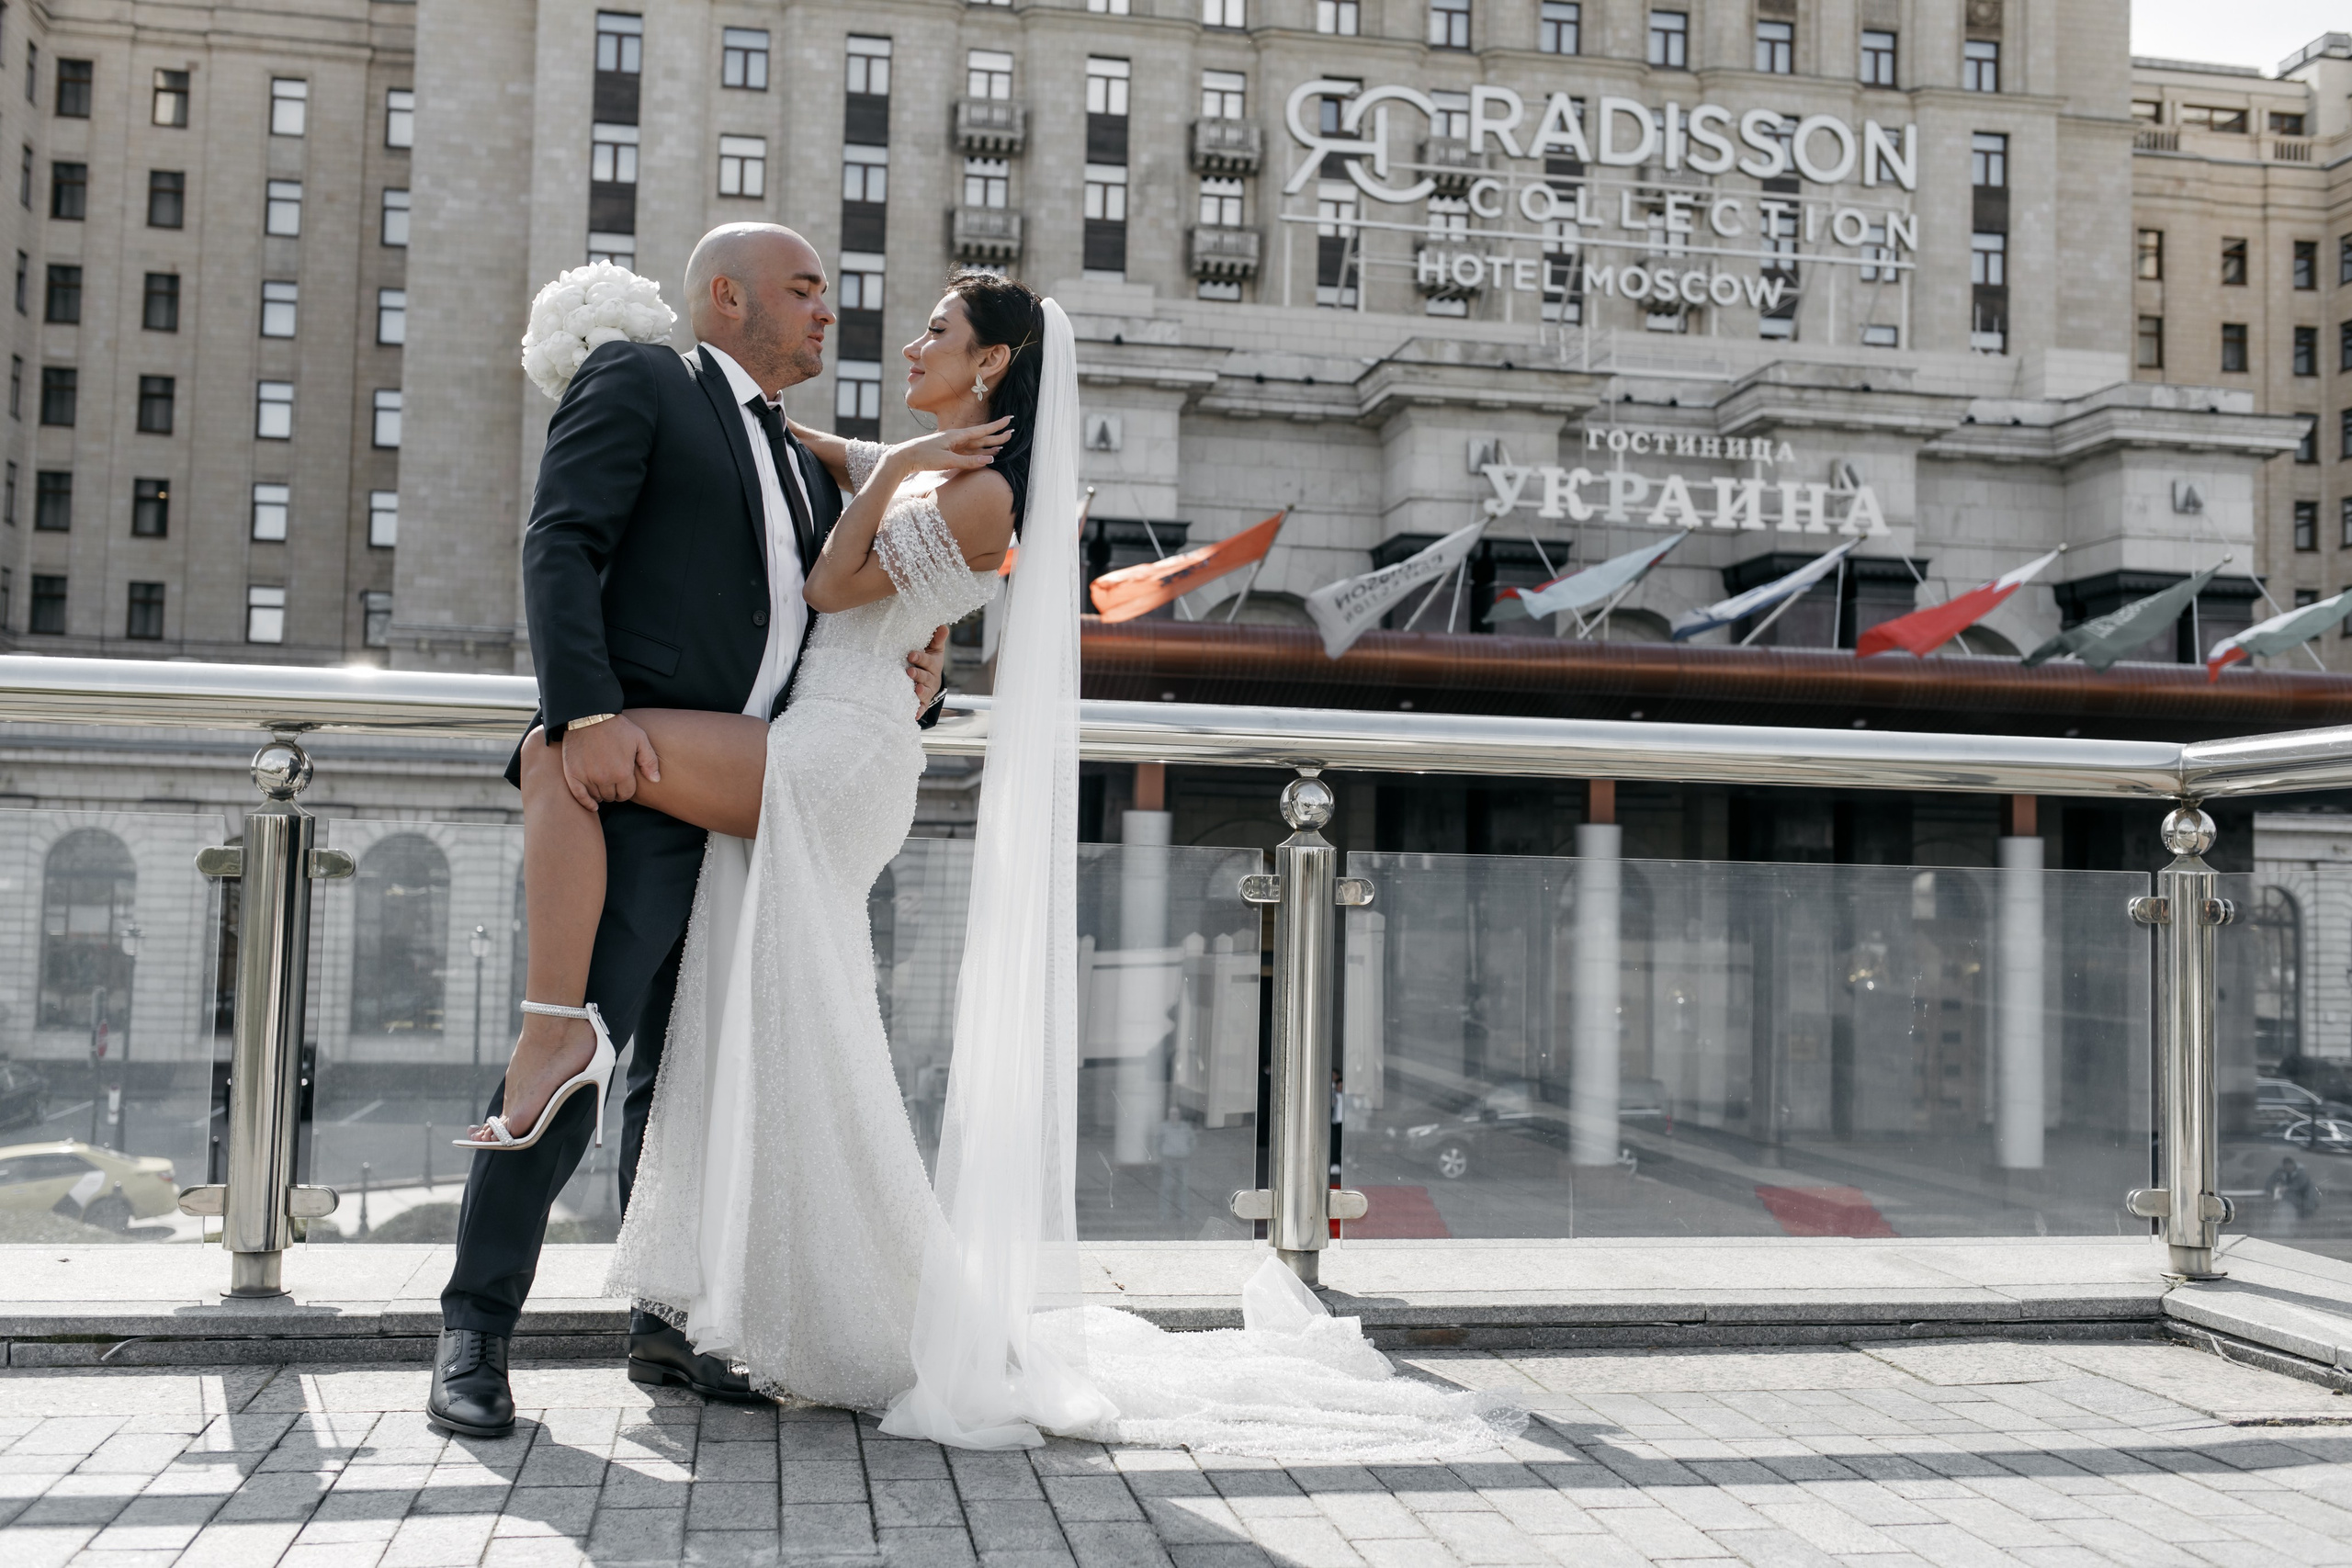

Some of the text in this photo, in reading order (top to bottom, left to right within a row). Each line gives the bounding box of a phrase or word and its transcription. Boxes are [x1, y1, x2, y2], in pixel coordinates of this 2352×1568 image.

[1470, 84, 1917, 191] RADISSON
[1469, 177, 1917, 252] COLLECTION
[1417, 250, 1786, 310] HOTEL MOSCOW
[1587, 426, 1795, 467] ГОСТИНИЦА
[1480, 464, 1891, 536] УКРАИНА
